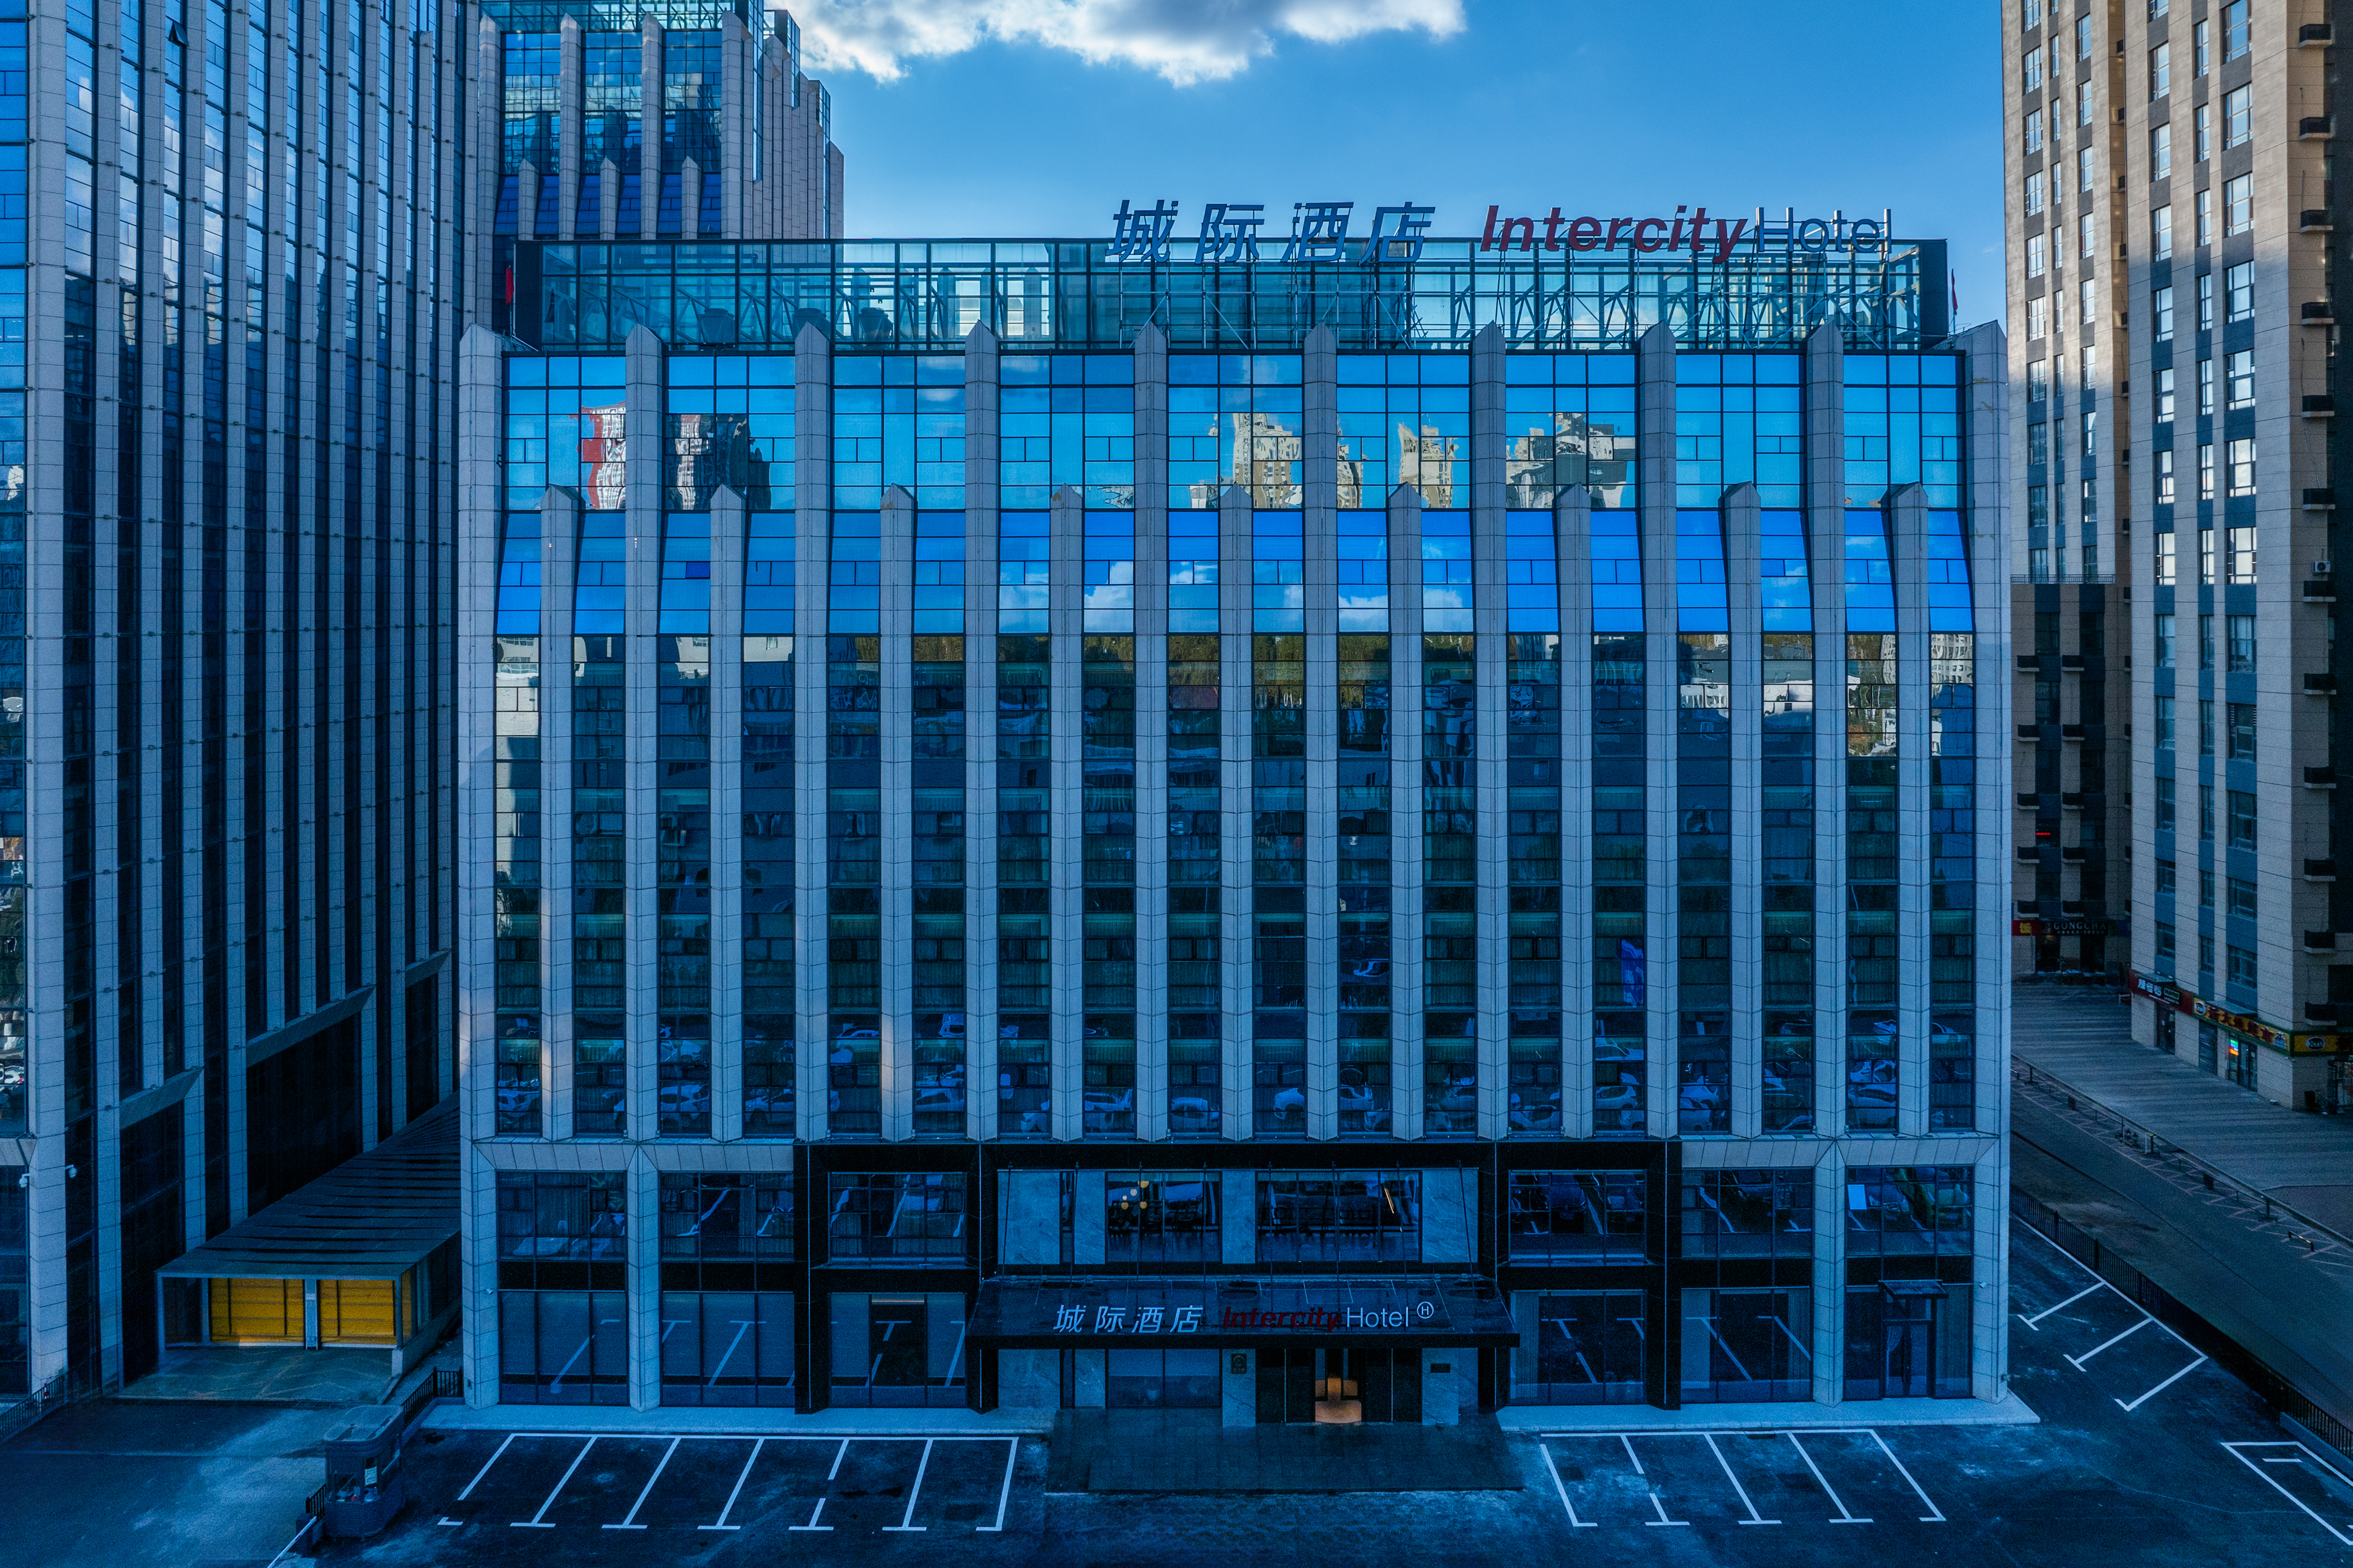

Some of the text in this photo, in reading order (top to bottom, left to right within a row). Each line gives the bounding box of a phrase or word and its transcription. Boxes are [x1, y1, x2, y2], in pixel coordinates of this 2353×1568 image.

[1105, 199, 1436, 265] 城际酒店
[1053, 1305, 1204, 1333] 城际酒店
